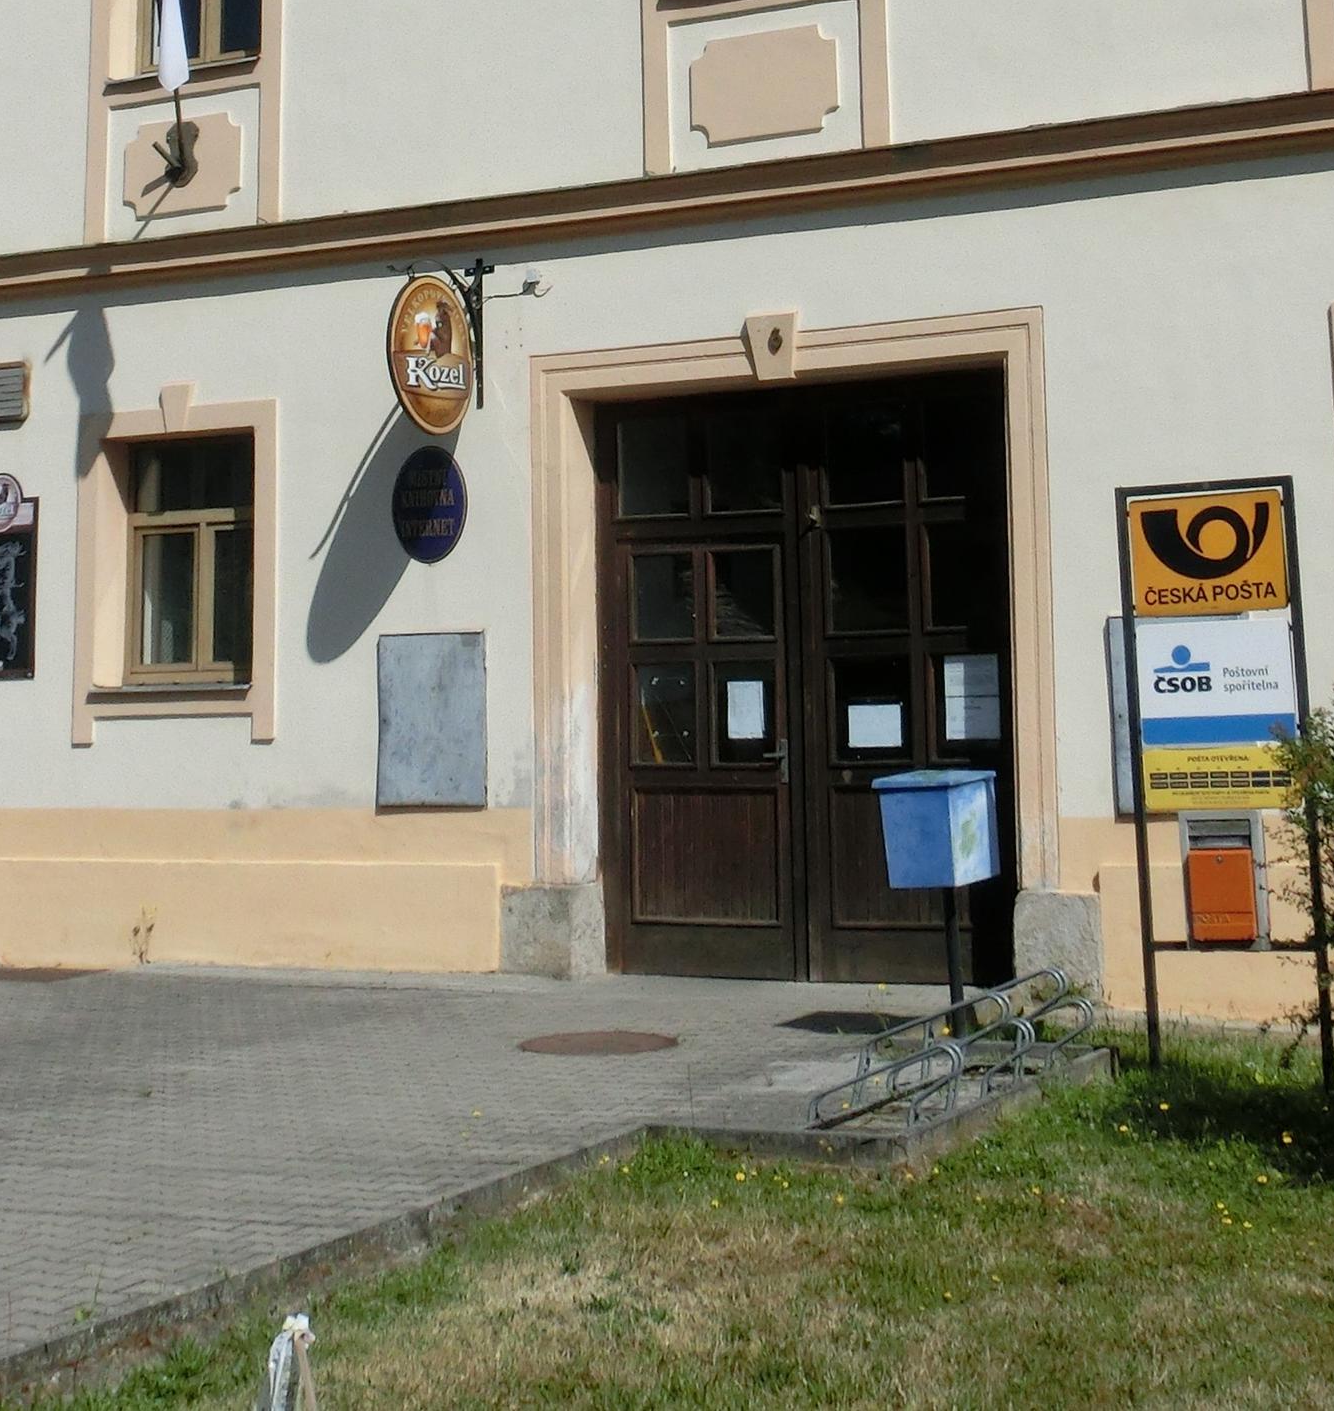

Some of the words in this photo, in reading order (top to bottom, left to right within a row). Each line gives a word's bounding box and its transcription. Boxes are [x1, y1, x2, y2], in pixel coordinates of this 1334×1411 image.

[405, 355, 467, 390] Kozel
[1144, 583, 1208, 606] ČESKÁ
[1212, 580, 1277, 602] POŠTA
[1222, 664, 1269, 679] Poštovní
[1153, 675, 1213, 694] ČSOB
[1223, 679, 1279, 694] spořitelna
